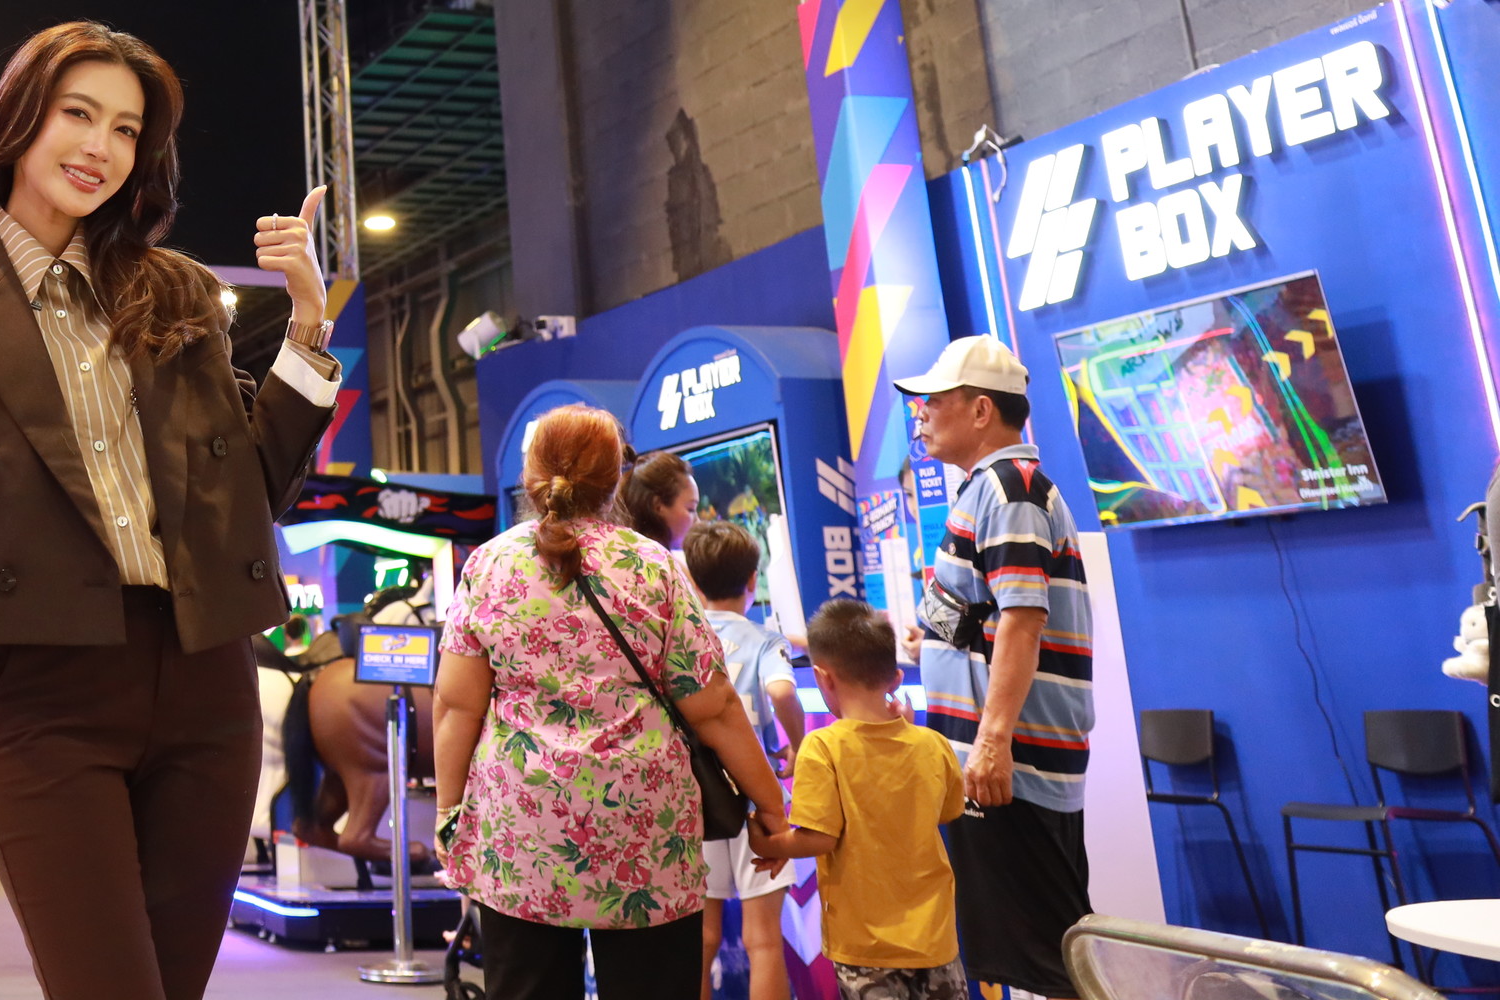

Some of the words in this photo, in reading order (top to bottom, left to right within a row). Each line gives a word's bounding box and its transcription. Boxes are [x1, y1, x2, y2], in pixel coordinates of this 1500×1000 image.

[1102, 40, 1390, 203] PLAYER
[1115, 173, 1257, 281] BOX
[681, 355, 742, 397] PLAYER
[1301, 466, 1346, 482] Sinister
[1346, 463, 1369, 476] Inn
[823, 526, 858, 598] BOX
[363, 653, 392, 664] CHECK
